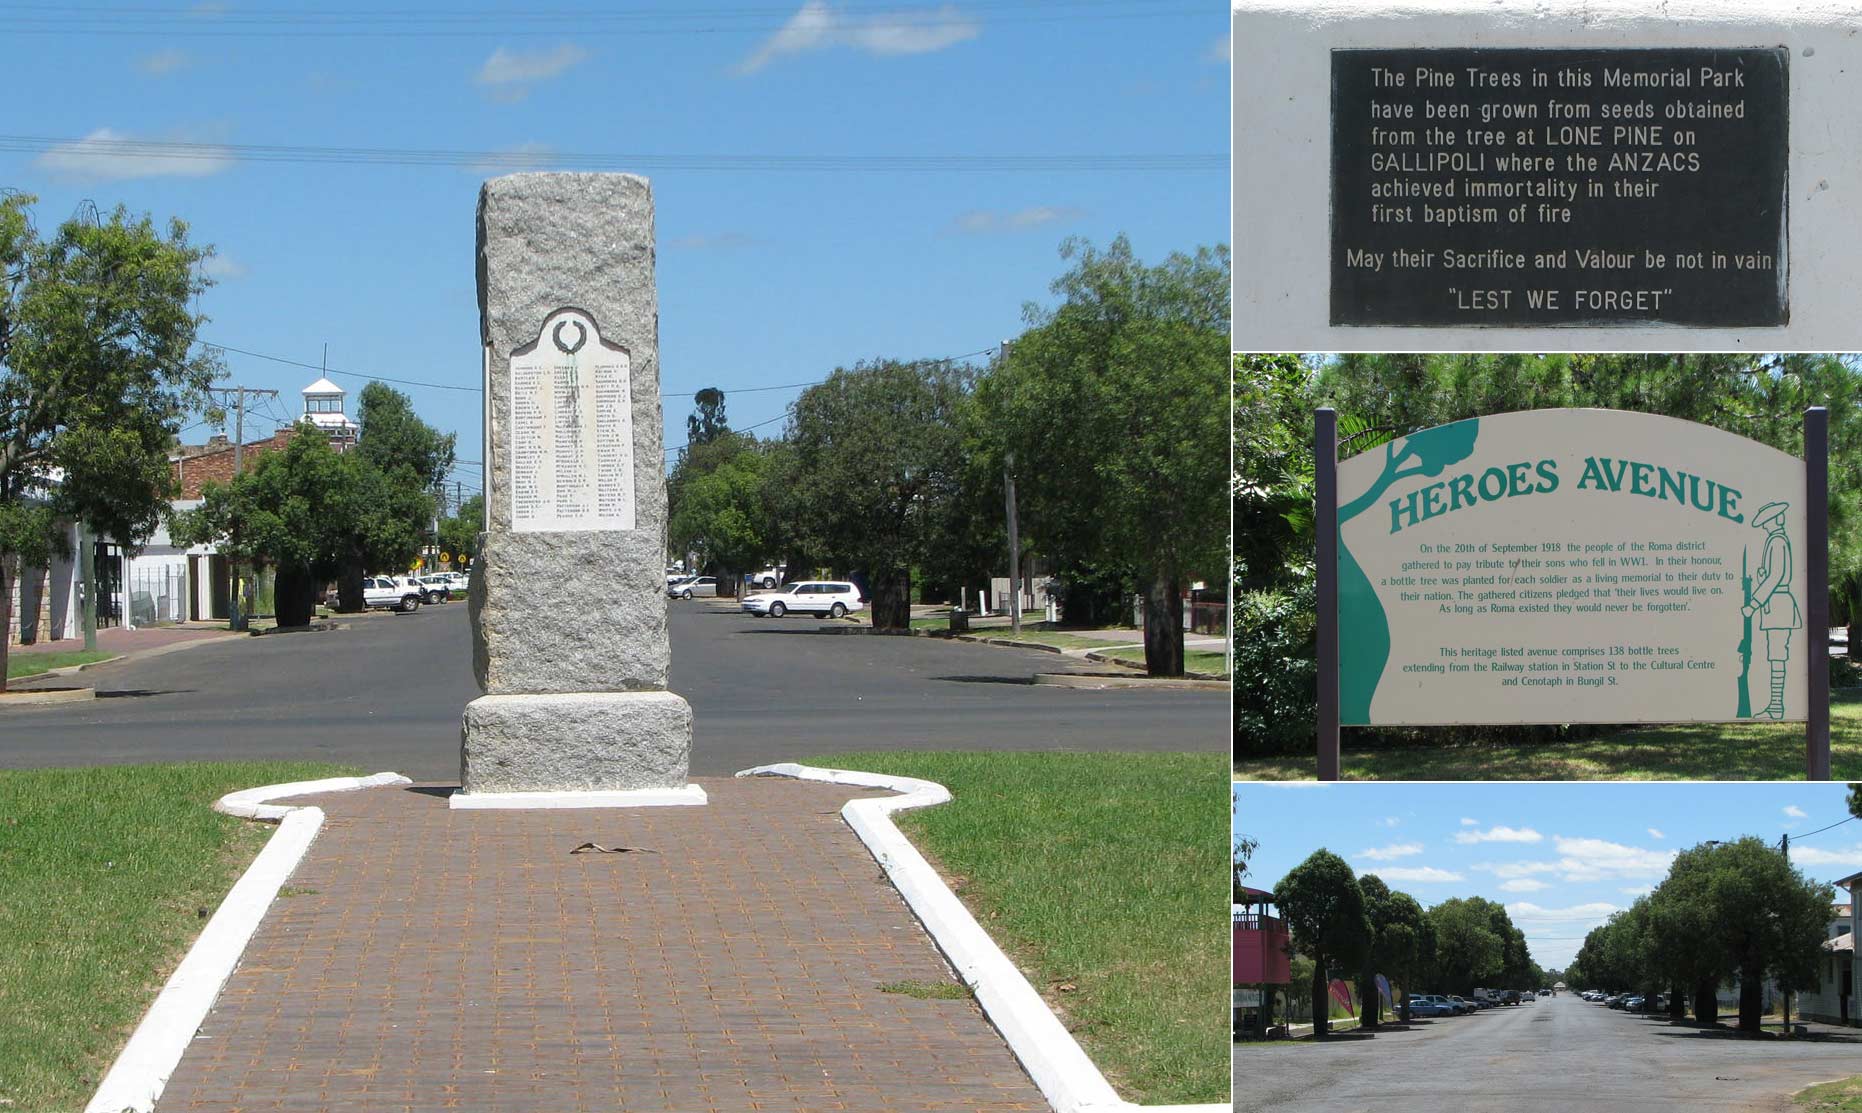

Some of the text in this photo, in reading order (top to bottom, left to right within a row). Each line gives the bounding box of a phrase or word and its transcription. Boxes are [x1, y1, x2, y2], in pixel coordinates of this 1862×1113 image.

[1370, 68, 1745, 87] The Pine Trees in this Memorial Park
[1370, 100, 1745, 122] have been grown from seeds obtained
[1370, 126, 1696, 145] from the tree at LONE PINE on
[1370, 153, 1701, 171] GALLIPOLI where the ANZACS
[1370, 178, 1660, 201] achieved immortality in their
[1370, 204, 1571, 226] first baptism of fire
[1346, 249, 1772, 271] May their Sacrifice and Valour be not in vain
[1448, 288, 1673, 309] "LEST WE FORGET"
[1388, 456, 1745, 535] HEROES AVENUE
[1420, 542, 1705, 554] On the 20th of September 1918 the people of the Roma district
[1401, 560, 1440, 571] gathered
[1443, 561, 1452, 569] to
[1456, 562, 1472, 571] pay
[1475, 560, 1504, 568] tribute
[1508, 559, 1517, 570] to
[1521, 559, 1541, 568] their
[1569, 558, 1588, 567] who
[1592, 557, 1605, 566] fell
[1608, 558, 1616, 566] in
[1655, 557, 1664, 565] In
[1667, 556, 1687, 565] their
[1691, 556, 1722, 565] honour,
[1390, 576, 1416, 585] bottle
[1420, 577, 1438, 585] tree
[1462, 576, 1495, 586] planted
[1498, 576, 1511, 584] for
[1514, 576, 1535, 584] each
[1539, 575, 1567, 584] soldier
[1595, 574, 1618, 584] living
[1621, 573, 1661, 582] memorial
[1665, 573, 1674, 581] to
[1677, 572, 1698, 581] their
[1701, 572, 1721, 580] duty
[1725, 572, 1734, 580] to
[1400, 592, 1420, 600] their
[1424, 592, 1454, 600] nation.
[1457, 591, 1474, 600] The
[1477, 590, 1516, 601] gathered
[1519, 590, 1553, 598] citizens
[1556, 589, 1590, 600] pledged
[1593, 588, 1611, 597] that
[1640, 587, 1659, 596] lives
[1663, 586, 1689, 595] would
[1692, 586, 1707, 595] live
[1439, 604, 1451, 613] As
[1454, 604, 1473, 615] long
[1490, 604, 1515, 612] Roma
[1518, 603, 1549, 612] existed
[1553, 603, 1572, 614] they
[1576, 603, 1602, 612] would
[1632, 603, 1643, 611] be
[1439, 648, 1458, 656] This
[1461, 648, 1497, 658] heritage
[1501, 648, 1524, 656] listed
[1561, 647, 1605, 657] comprises
[1608, 646, 1625, 655] 138
[1628, 646, 1653, 655] bottle
[1657, 647, 1680, 655] trees
[1402, 660, 1716, 674] extending from the Railway station in Station St to the Cultural Centre
[1501, 676, 1618, 687] and Cenotaph in Bungil St.
